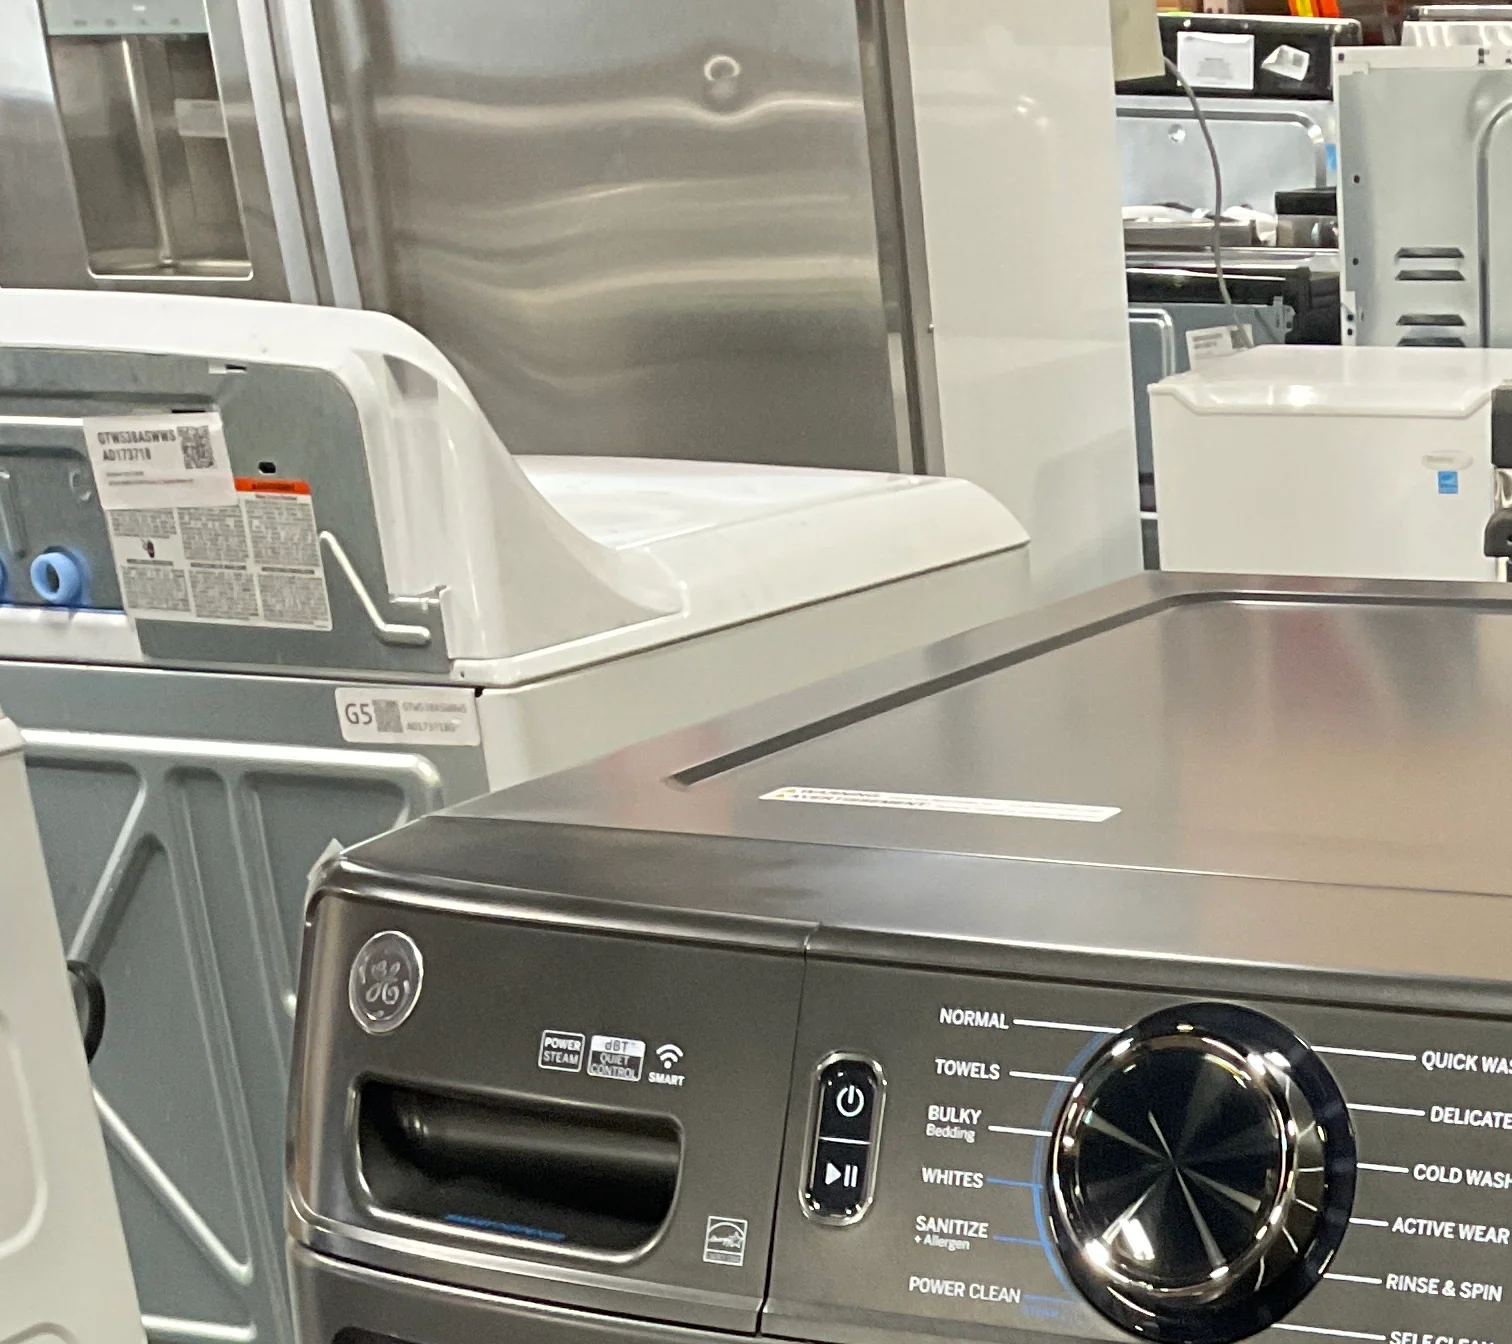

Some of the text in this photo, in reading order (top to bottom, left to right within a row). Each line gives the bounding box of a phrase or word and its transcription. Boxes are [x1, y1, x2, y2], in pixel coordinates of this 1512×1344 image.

[344, 702, 373, 726] G5
[938, 1007, 1010, 1030] NORMAL
[543, 1036, 582, 1052] POWER
[543, 1050, 580, 1065] STEAM
[600, 1052, 631, 1066] QUIET
[1421, 1050, 1479, 1072] QUICK
[590, 1063, 637, 1080] CONTROL
[647, 1071, 686, 1087] SMART
[934, 1057, 1001, 1080] TOWELS
[927, 1105, 983, 1126] BULKY
[925, 1123, 977, 1144] Bedding
[921, 1165, 985, 1189] WHITES
[1413, 1163, 1463, 1184] COLD
[915, 1215, 990, 1239] SANITIZE
[1391, 1216, 1511, 1245] ACTIVE WEAR
[922, 1233, 971, 1252] Allergen
[908, 1275, 1022, 1304] POWER CLEAN
[1385, 1273, 1503, 1302] RINSE & SPIN
